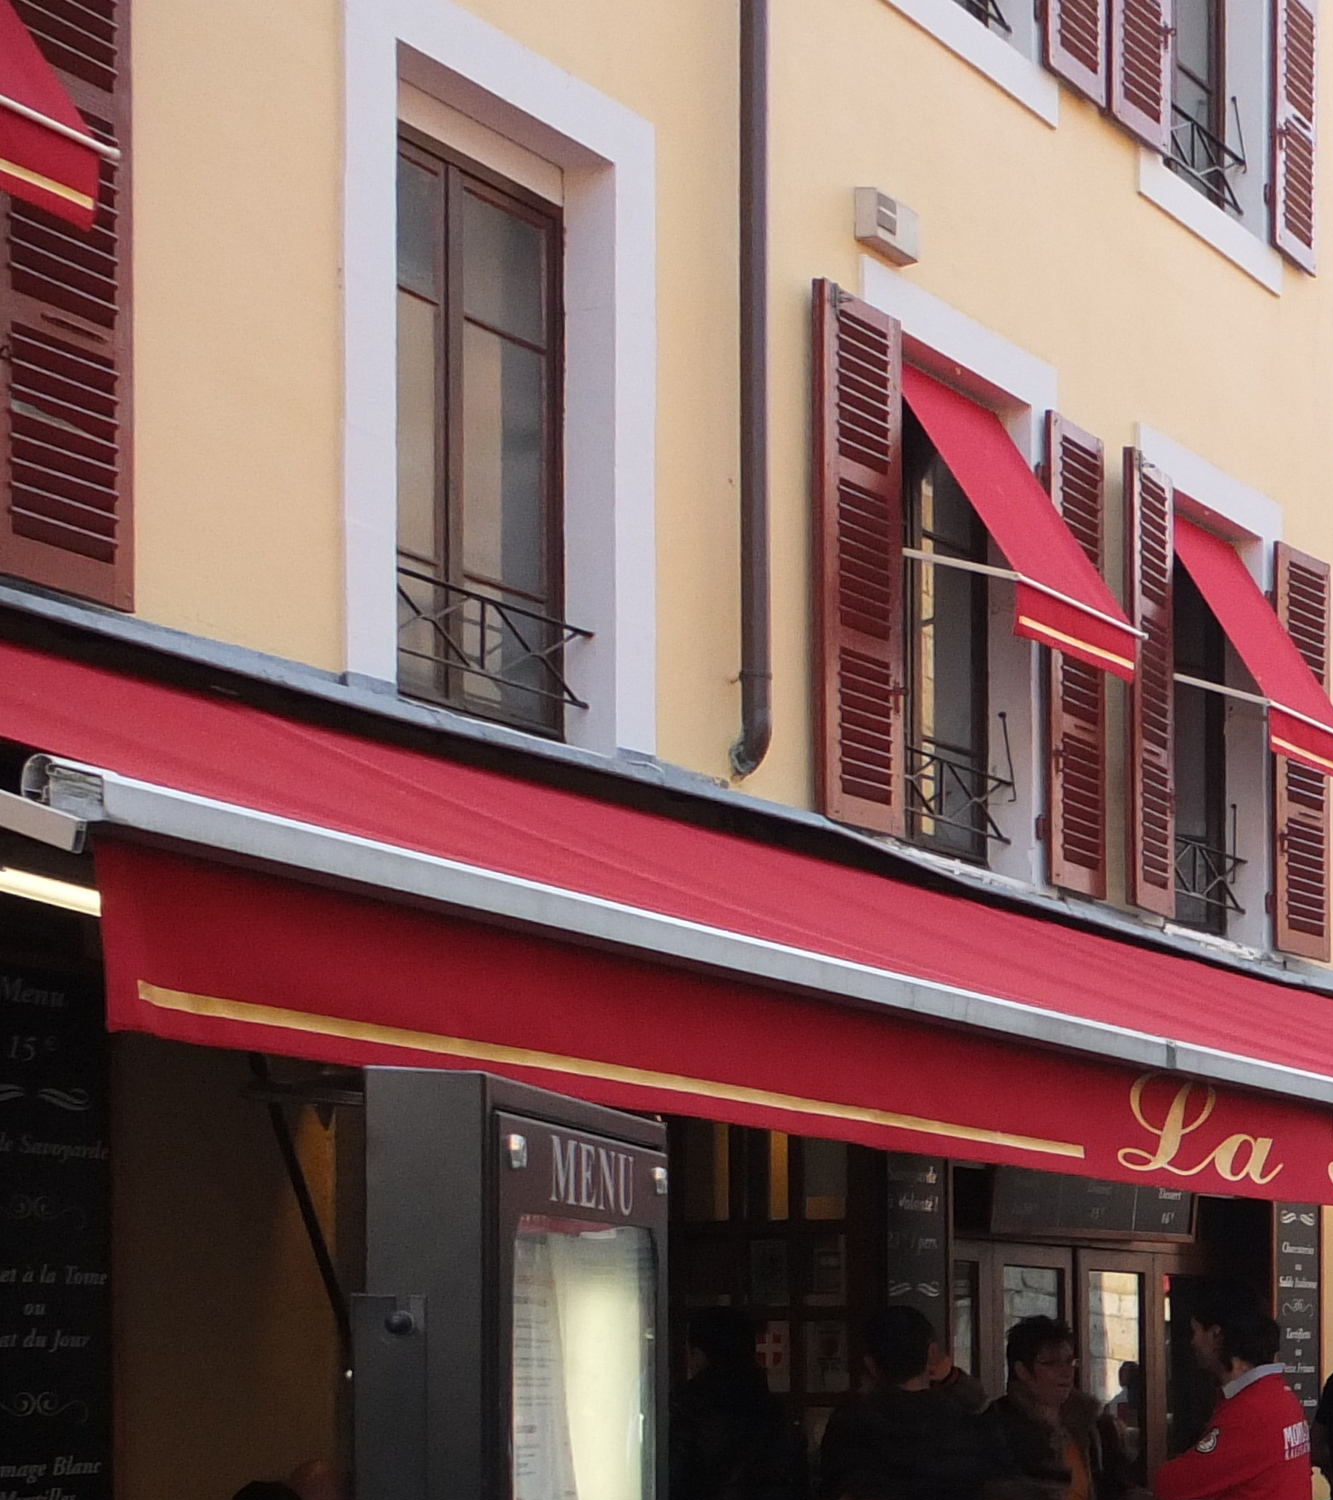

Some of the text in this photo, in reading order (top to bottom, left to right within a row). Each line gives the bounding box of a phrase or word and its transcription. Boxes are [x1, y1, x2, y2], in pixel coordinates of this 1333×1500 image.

[1117, 1073, 1283, 1185] La
[551, 1135, 635, 1217] MENU
[39, 1263, 56, 1284] la
[23, 1303, 46, 1317] ou
[22, 1327, 48, 1348] du
[48, 1328, 91, 1353] Jour
[53, 1455, 103, 1477] Blanc
